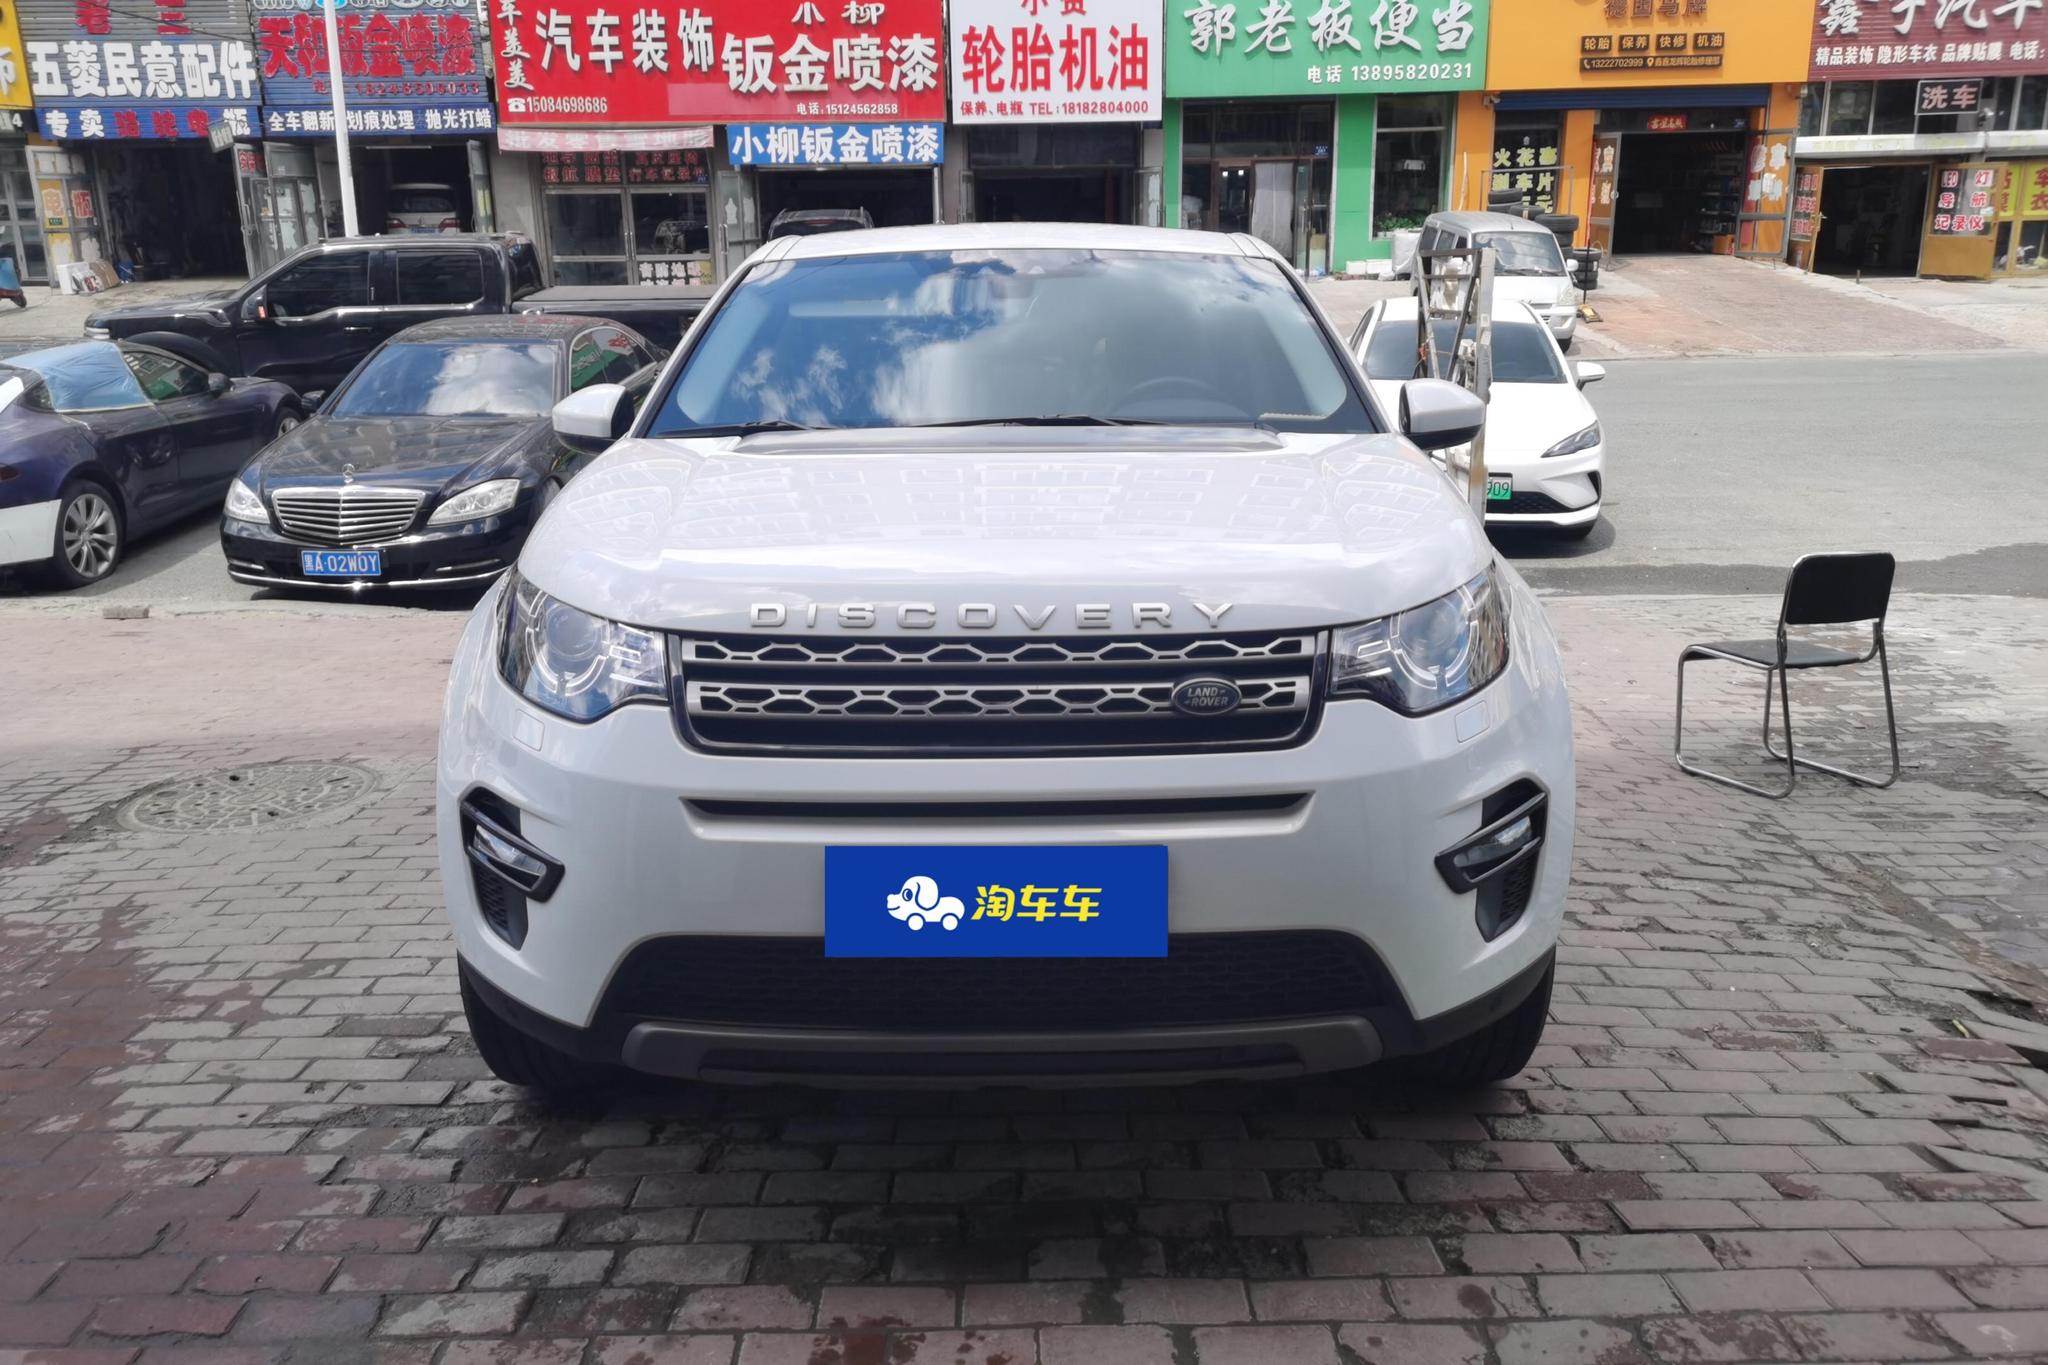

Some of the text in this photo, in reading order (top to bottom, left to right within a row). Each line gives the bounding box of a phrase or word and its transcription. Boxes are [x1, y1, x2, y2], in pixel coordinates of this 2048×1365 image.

[791, 2, 885, 25] 小柳
[1184, 0, 1475, 56] 郭老板便当
[535, 8, 714, 74] 汽车装饰
[1584, 34, 1723, 50] 轮胎 保养 快修 机油
[720, 33, 940, 93] 钣金喷漆
[962, 23, 1149, 94] 轮胎机油
[1815, 46, 1875, 66] 精品装饰
[1877, 44, 1938, 64] 隐形车衣
[1941, 42, 2003, 63] 品牌贴膜
[26, 40, 256, 99] 五菱民意配件
[1307, 63, 1472, 83] 电话 13895820231
[526, 96, 608, 113] 15084698686
[1921, 84, 1978, 109] 洗车
[425, 107, 492, 129] 抛光打蜡
[732, 125, 940, 164] 小柳钣金喷漆
[1493, 146, 1558, 168] 火花塞
[1934, 213, 1985, 231] 记录仪
[750, 602, 1234, 630] DISCOVERY
[1188, 687, 1218, 697] LAND
[1191, 696, 1228, 707] ROVER
